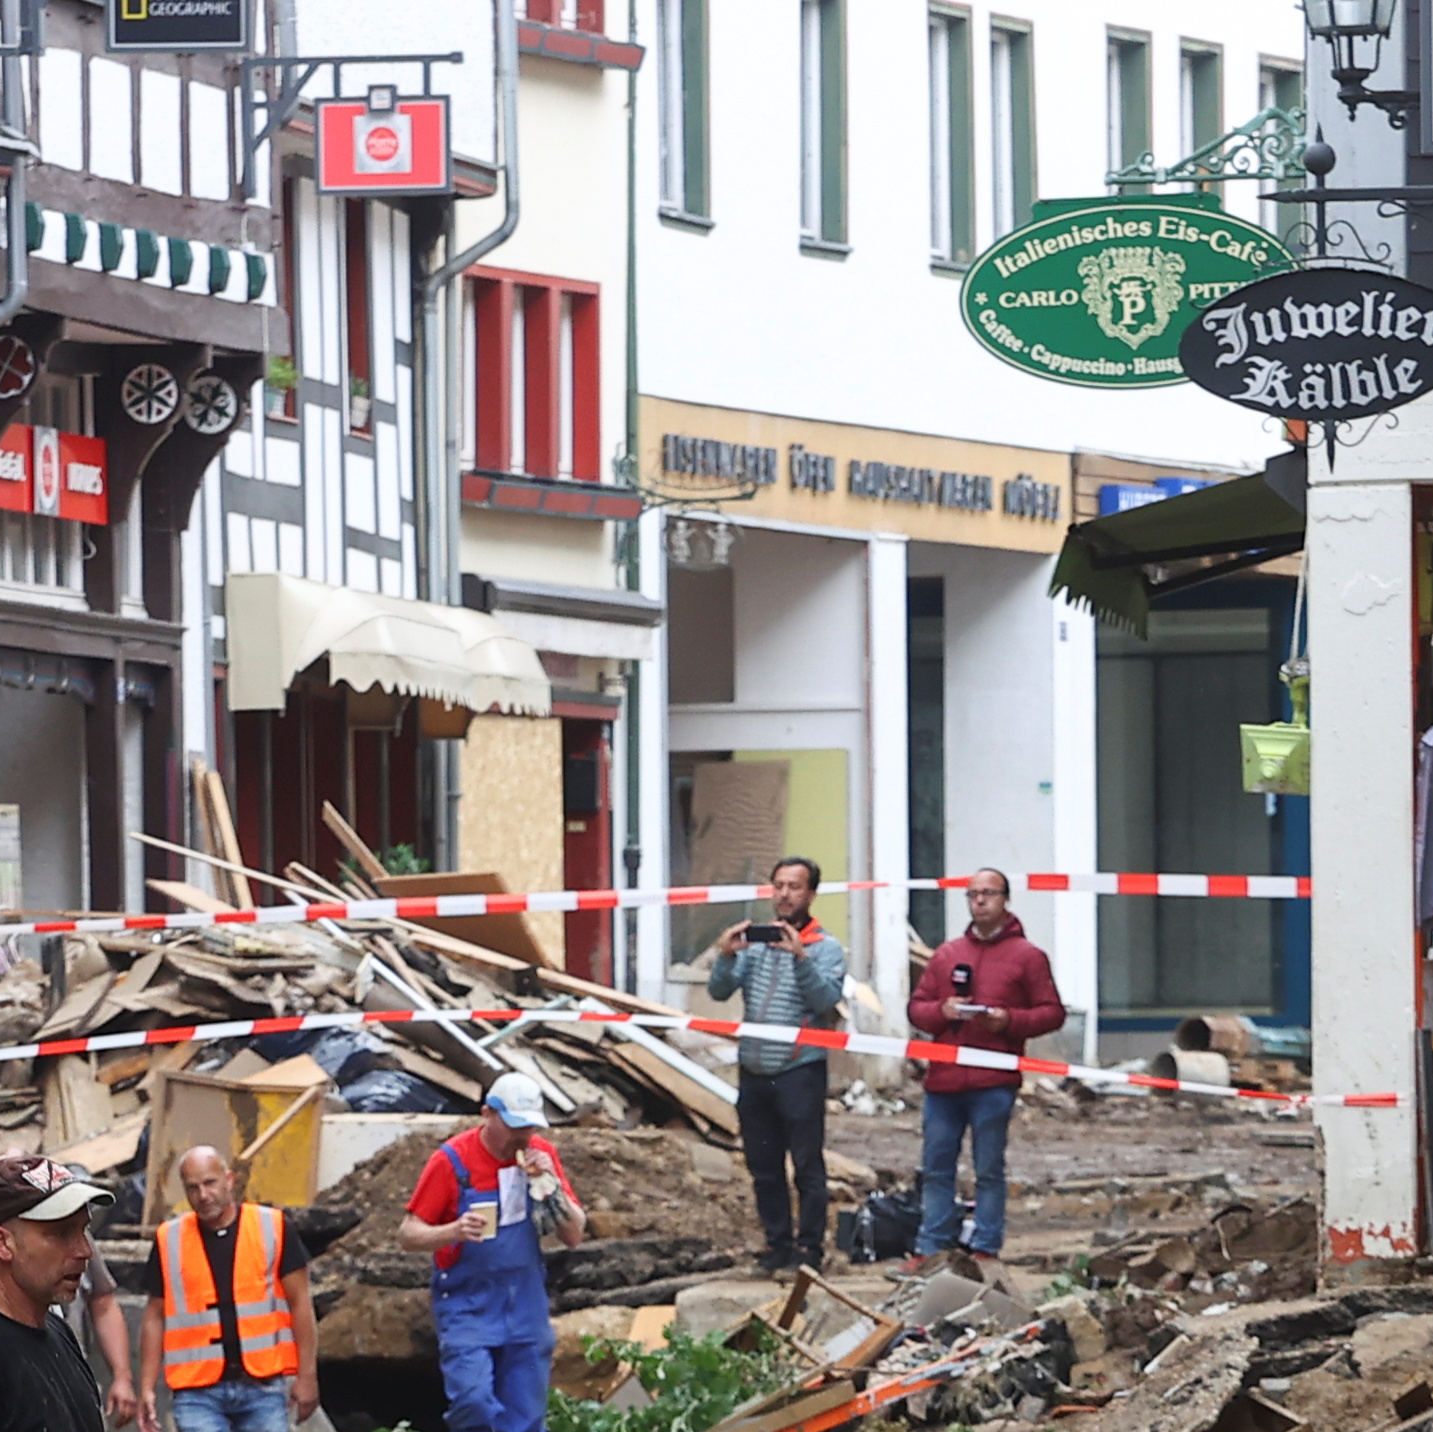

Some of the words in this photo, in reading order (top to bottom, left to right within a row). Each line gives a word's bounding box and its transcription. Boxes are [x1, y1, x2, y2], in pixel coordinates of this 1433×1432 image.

[149, 2, 233, 17] GEOGRAPHIC
[993, 216, 1153, 279] Italienisches
[1158, 215, 1269, 267] Eis-Café
[998, 288, 1079, 309] CARLO
[978, 308, 1024, 352] Caffee
[1030, 343, 1127, 376] Cappuccino
[1229, 353, 1423, 411] Kälble
